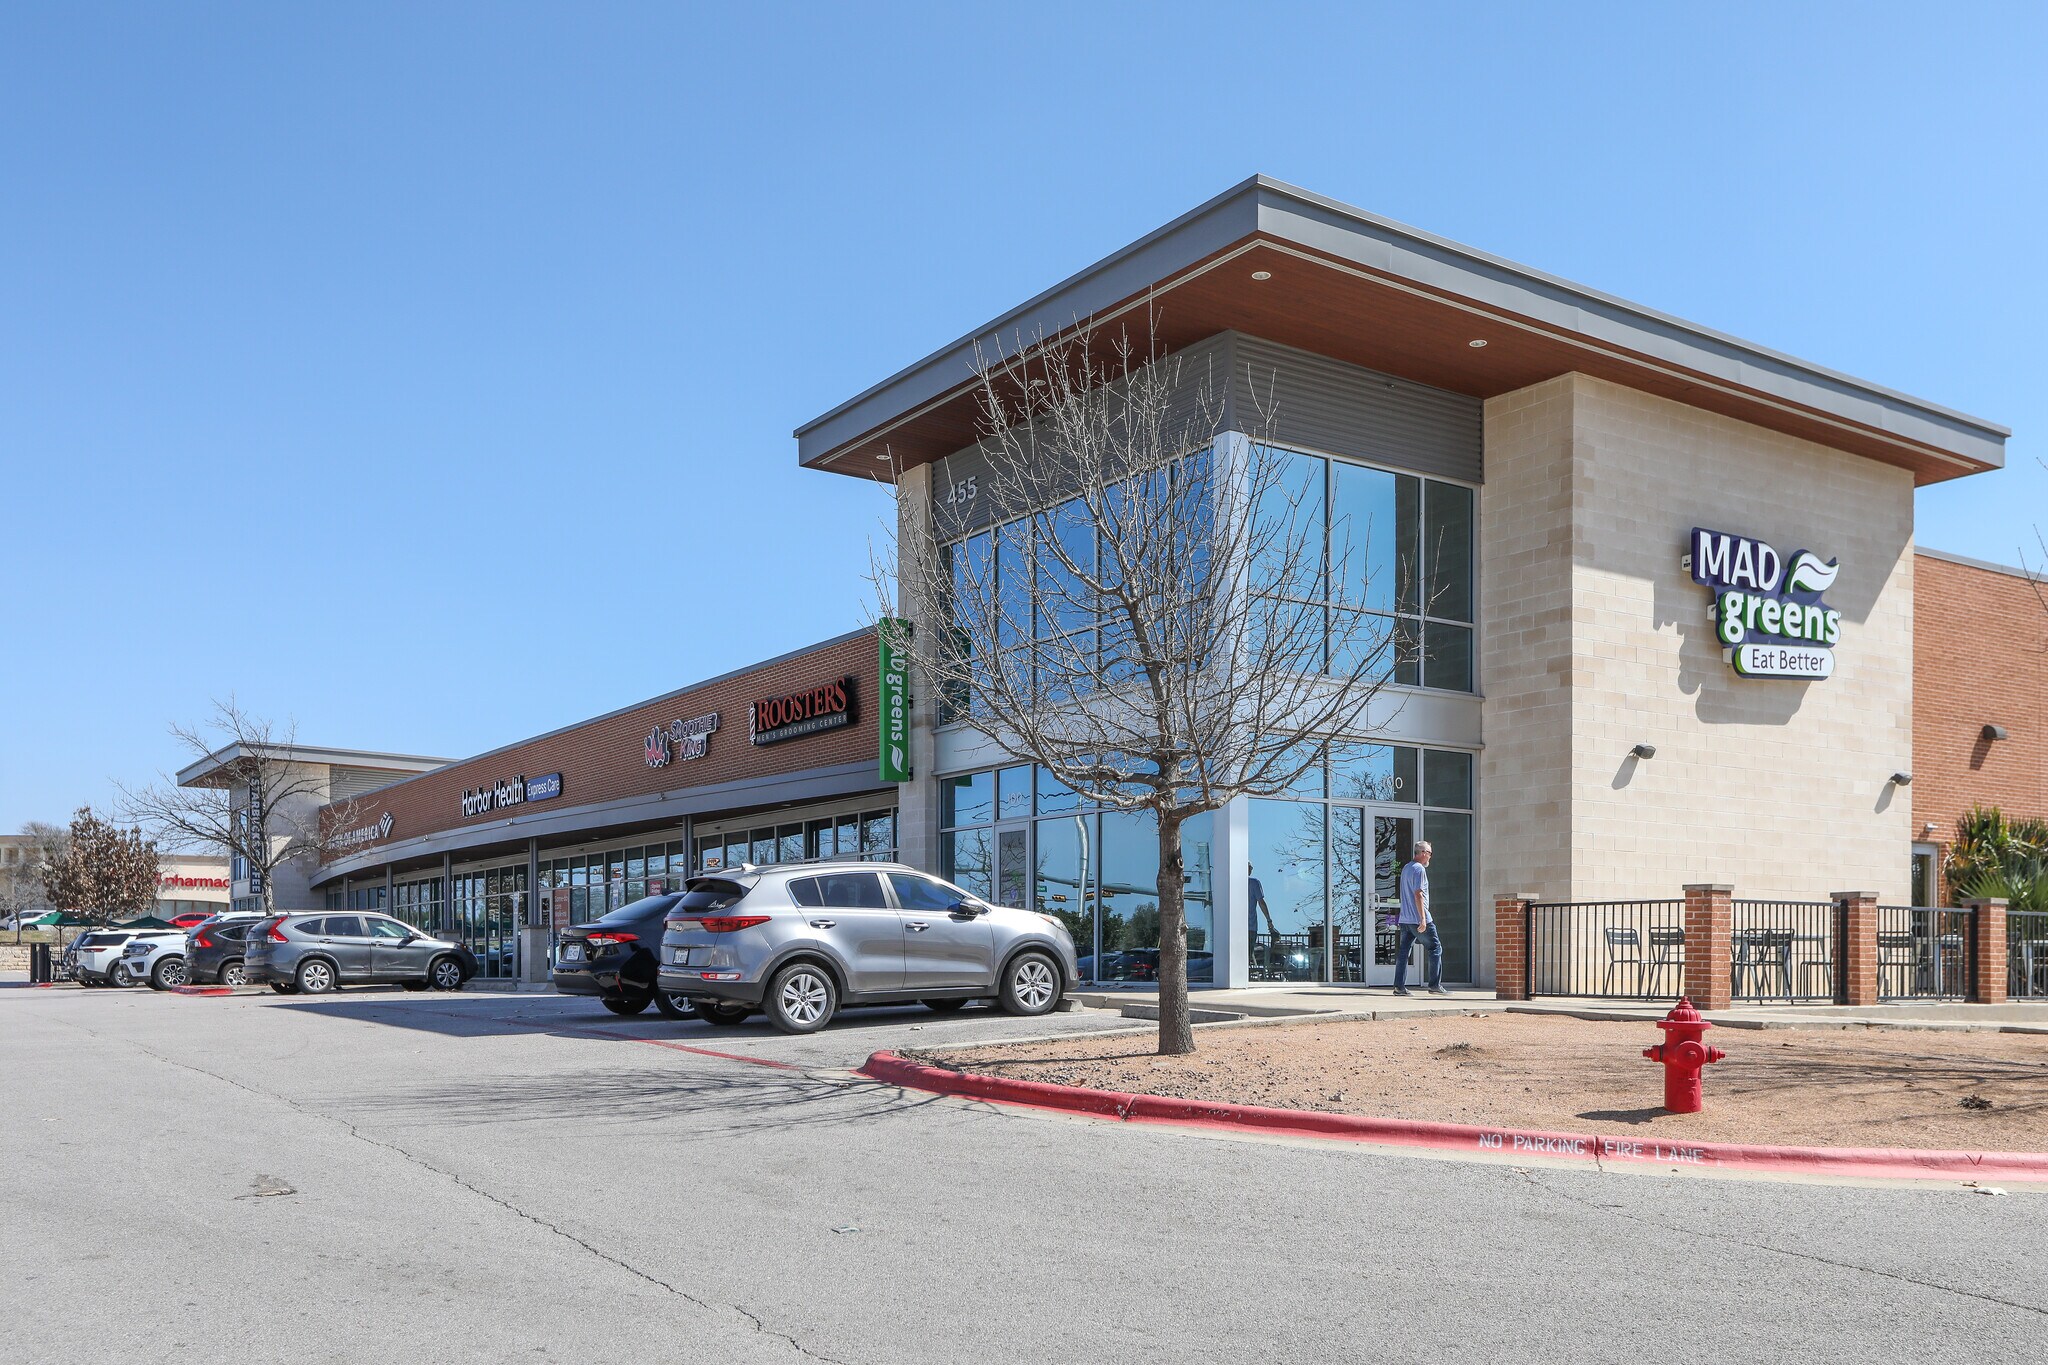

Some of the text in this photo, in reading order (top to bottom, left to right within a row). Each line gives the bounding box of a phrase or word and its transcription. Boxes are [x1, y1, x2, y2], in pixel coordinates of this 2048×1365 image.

[947, 475, 977, 504] 455
[1699, 531, 1780, 591] MAD
[1724, 591, 1840, 643] greens
[1752, 648, 1825, 671] Eat Better
[756, 676, 847, 732] ROOSTERS
[886, 672, 903, 741] greens
[670, 714, 714, 741] SMOOTHIE
[756, 714, 847, 743] MEN'S GROOMING CENTER
[680, 738, 702, 759] KING
[462, 774, 560, 816] Harbor Health Express Care
[351, 824, 379, 844] AMERICA
[164, 873, 230, 889] pharmac
[1479, 1133, 1705, 1165] NO PARKING FIRE LANE
